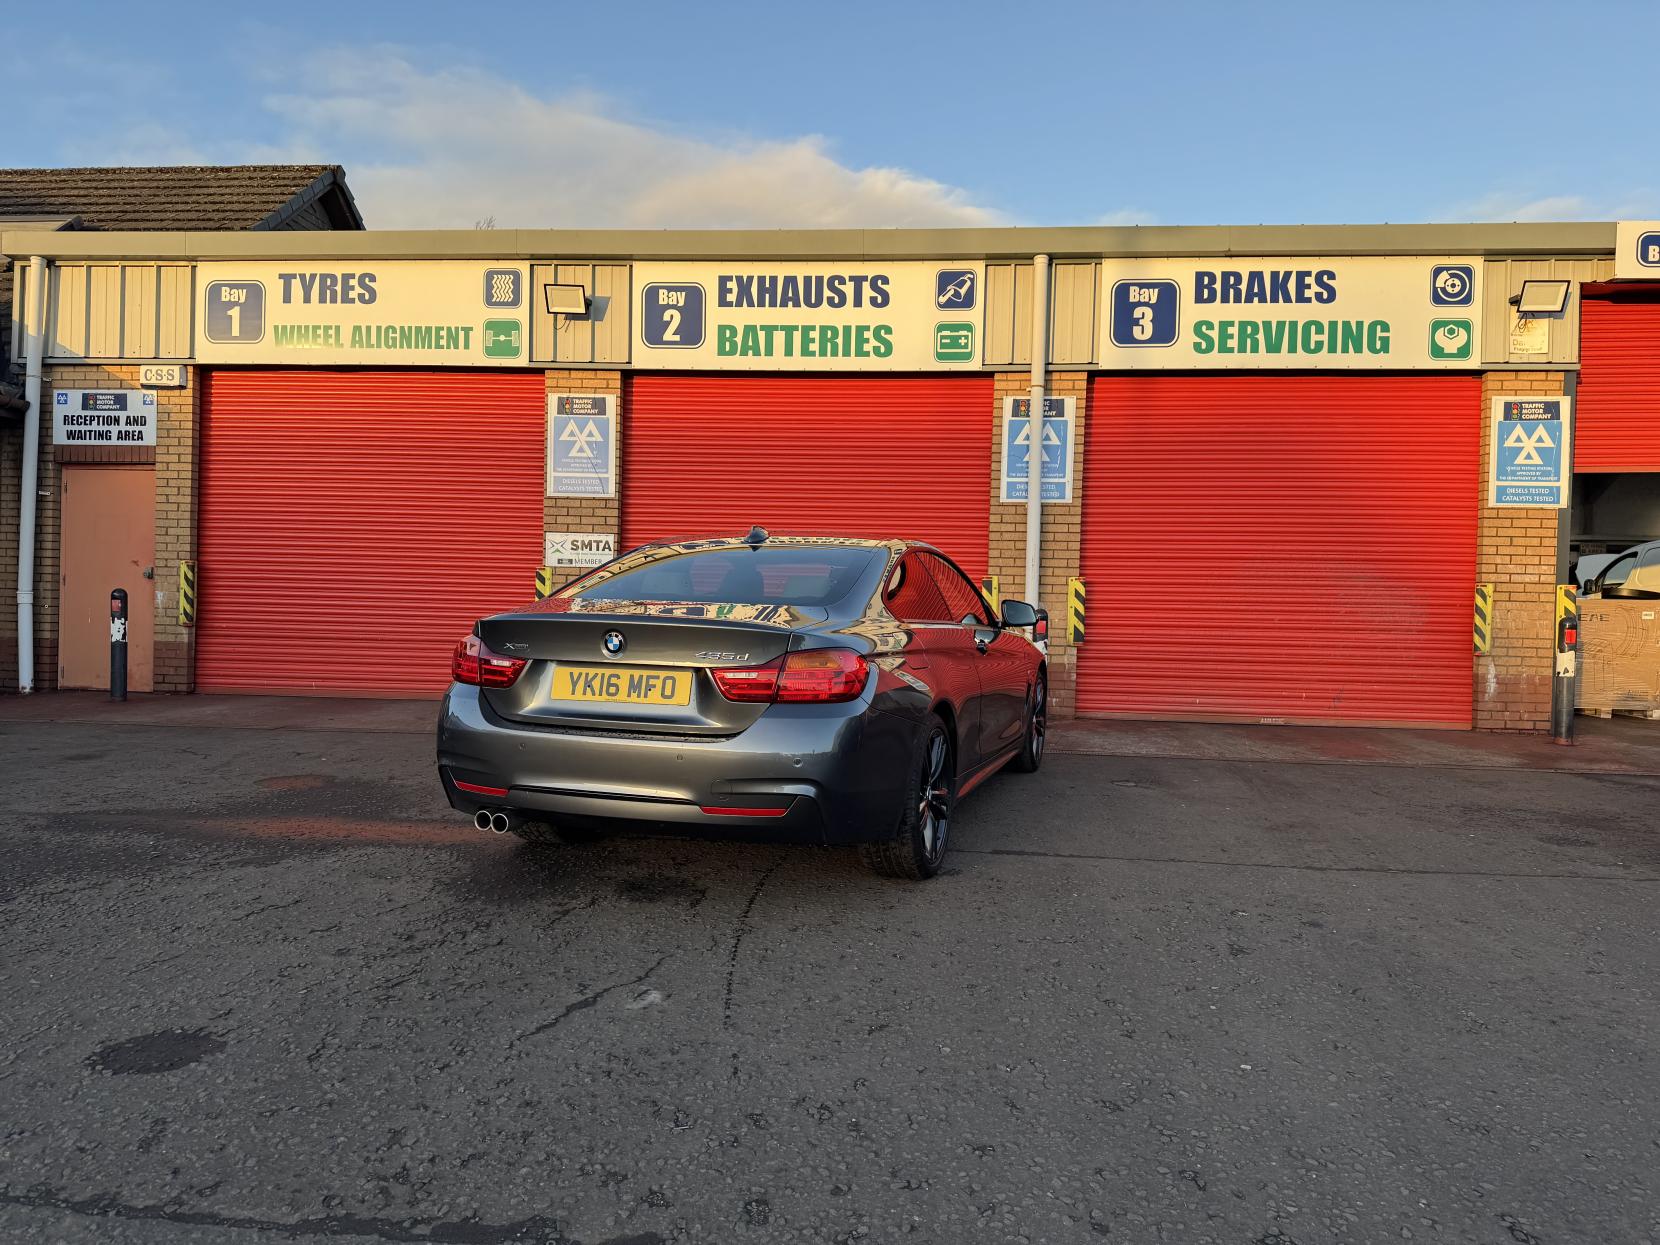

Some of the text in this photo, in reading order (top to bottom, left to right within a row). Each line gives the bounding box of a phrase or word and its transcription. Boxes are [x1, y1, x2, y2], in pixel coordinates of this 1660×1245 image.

[221, 287, 247, 303] Bay
[278, 272, 377, 304] TYRES
[658, 289, 686, 306] Bay
[718, 274, 890, 309] EXHAUSTS
[1129, 286, 1159, 303] Bay
[1194, 270, 1337, 304] BRAKES
[226, 306, 241, 337] 1
[662, 309, 682, 342] 2
[1132, 306, 1153, 341] 3
[273, 324, 474, 350] WHEEL ALIGNMENT
[717, 324, 893, 358] BATTERIES
[1193, 320, 1391, 354] SERVICING
[63, 415, 147, 427] RECEPTION AND
[66, 430, 144, 441] WAITING AREA
[570, 539, 612, 551] SMTA
[574, 558, 603, 566] MEMBER
[695, 651, 749, 661] 435d
[569, 671, 677, 699] YK16 MFO
